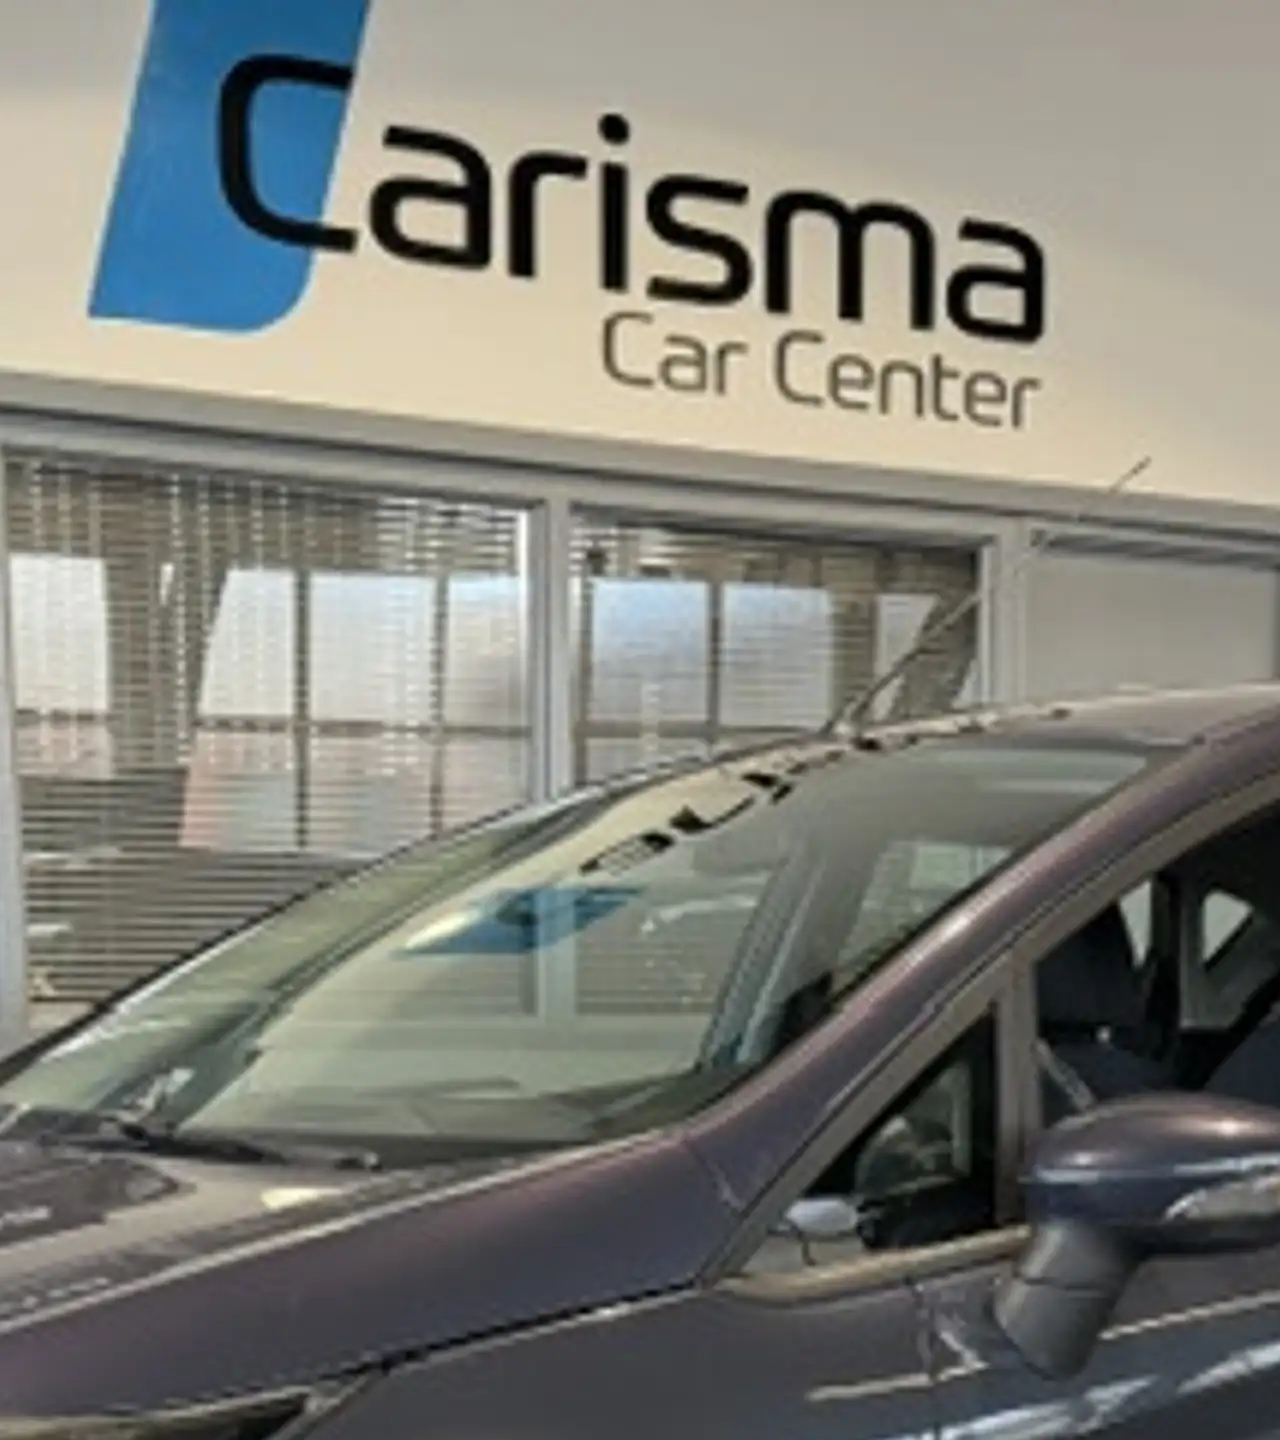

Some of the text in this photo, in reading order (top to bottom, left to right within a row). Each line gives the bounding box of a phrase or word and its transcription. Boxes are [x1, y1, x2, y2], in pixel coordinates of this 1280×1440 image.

[215, 52, 1046, 344] Carisma
[600, 311, 1042, 430] Car Center
